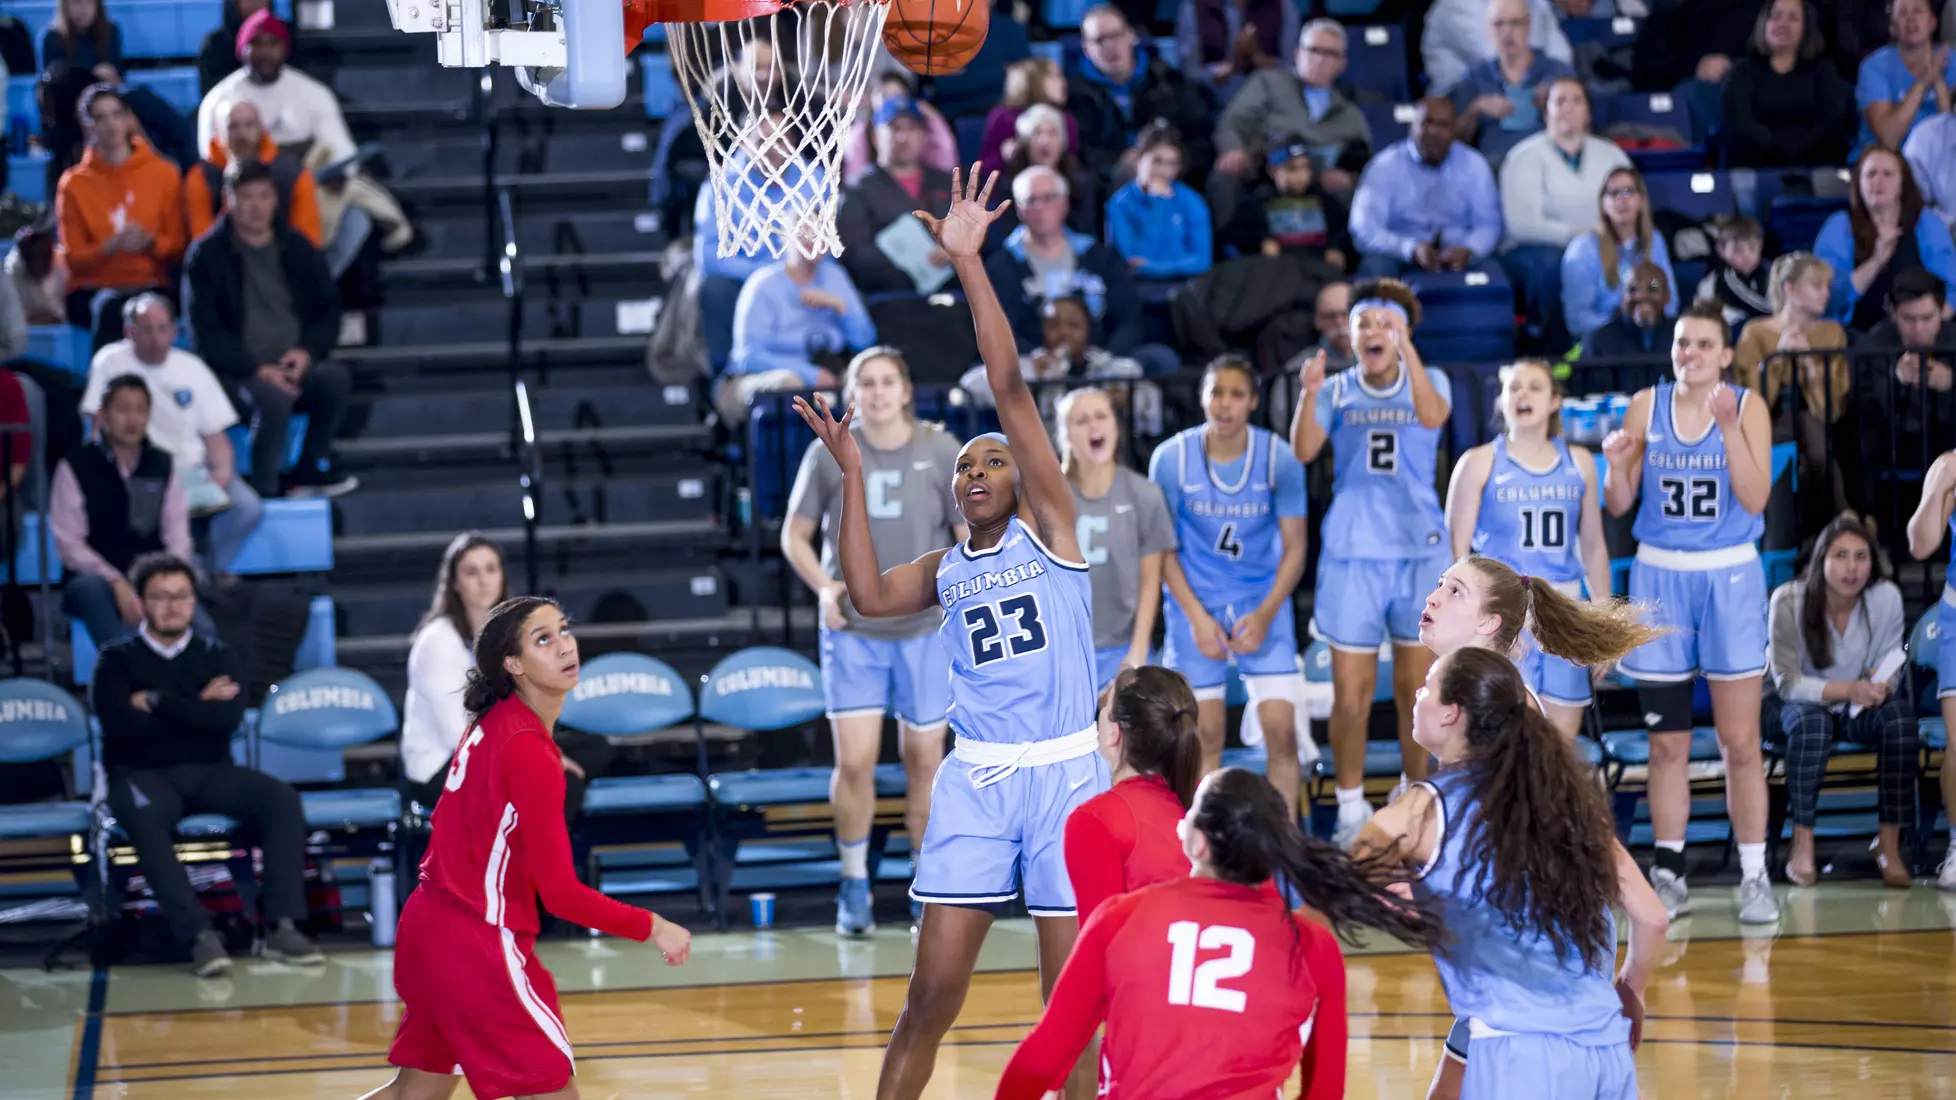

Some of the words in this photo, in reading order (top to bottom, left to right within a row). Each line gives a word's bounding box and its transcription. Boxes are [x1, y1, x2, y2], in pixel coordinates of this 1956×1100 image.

[1366, 429, 1399, 475] 2
[867, 469, 902, 519] C
[1496, 485, 1580, 503] COLUMBIA
[1659, 475, 1720, 522] 32
[1075, 513, 1109, 566] C
[1214, 521, 1244, 561] 4
[1518, 506, 1567, 552] 10
[942, 558, 1046, 609] COLUMBIA
[961, 592, 1049, 669] 23
[275, 685, 374, 715] COLUMBIA
[573, 672, 672, 702] COLUMBIA
[715, 665, 814, 696] COLUMBIA
[1167, 919, 1256, 1014] 12
